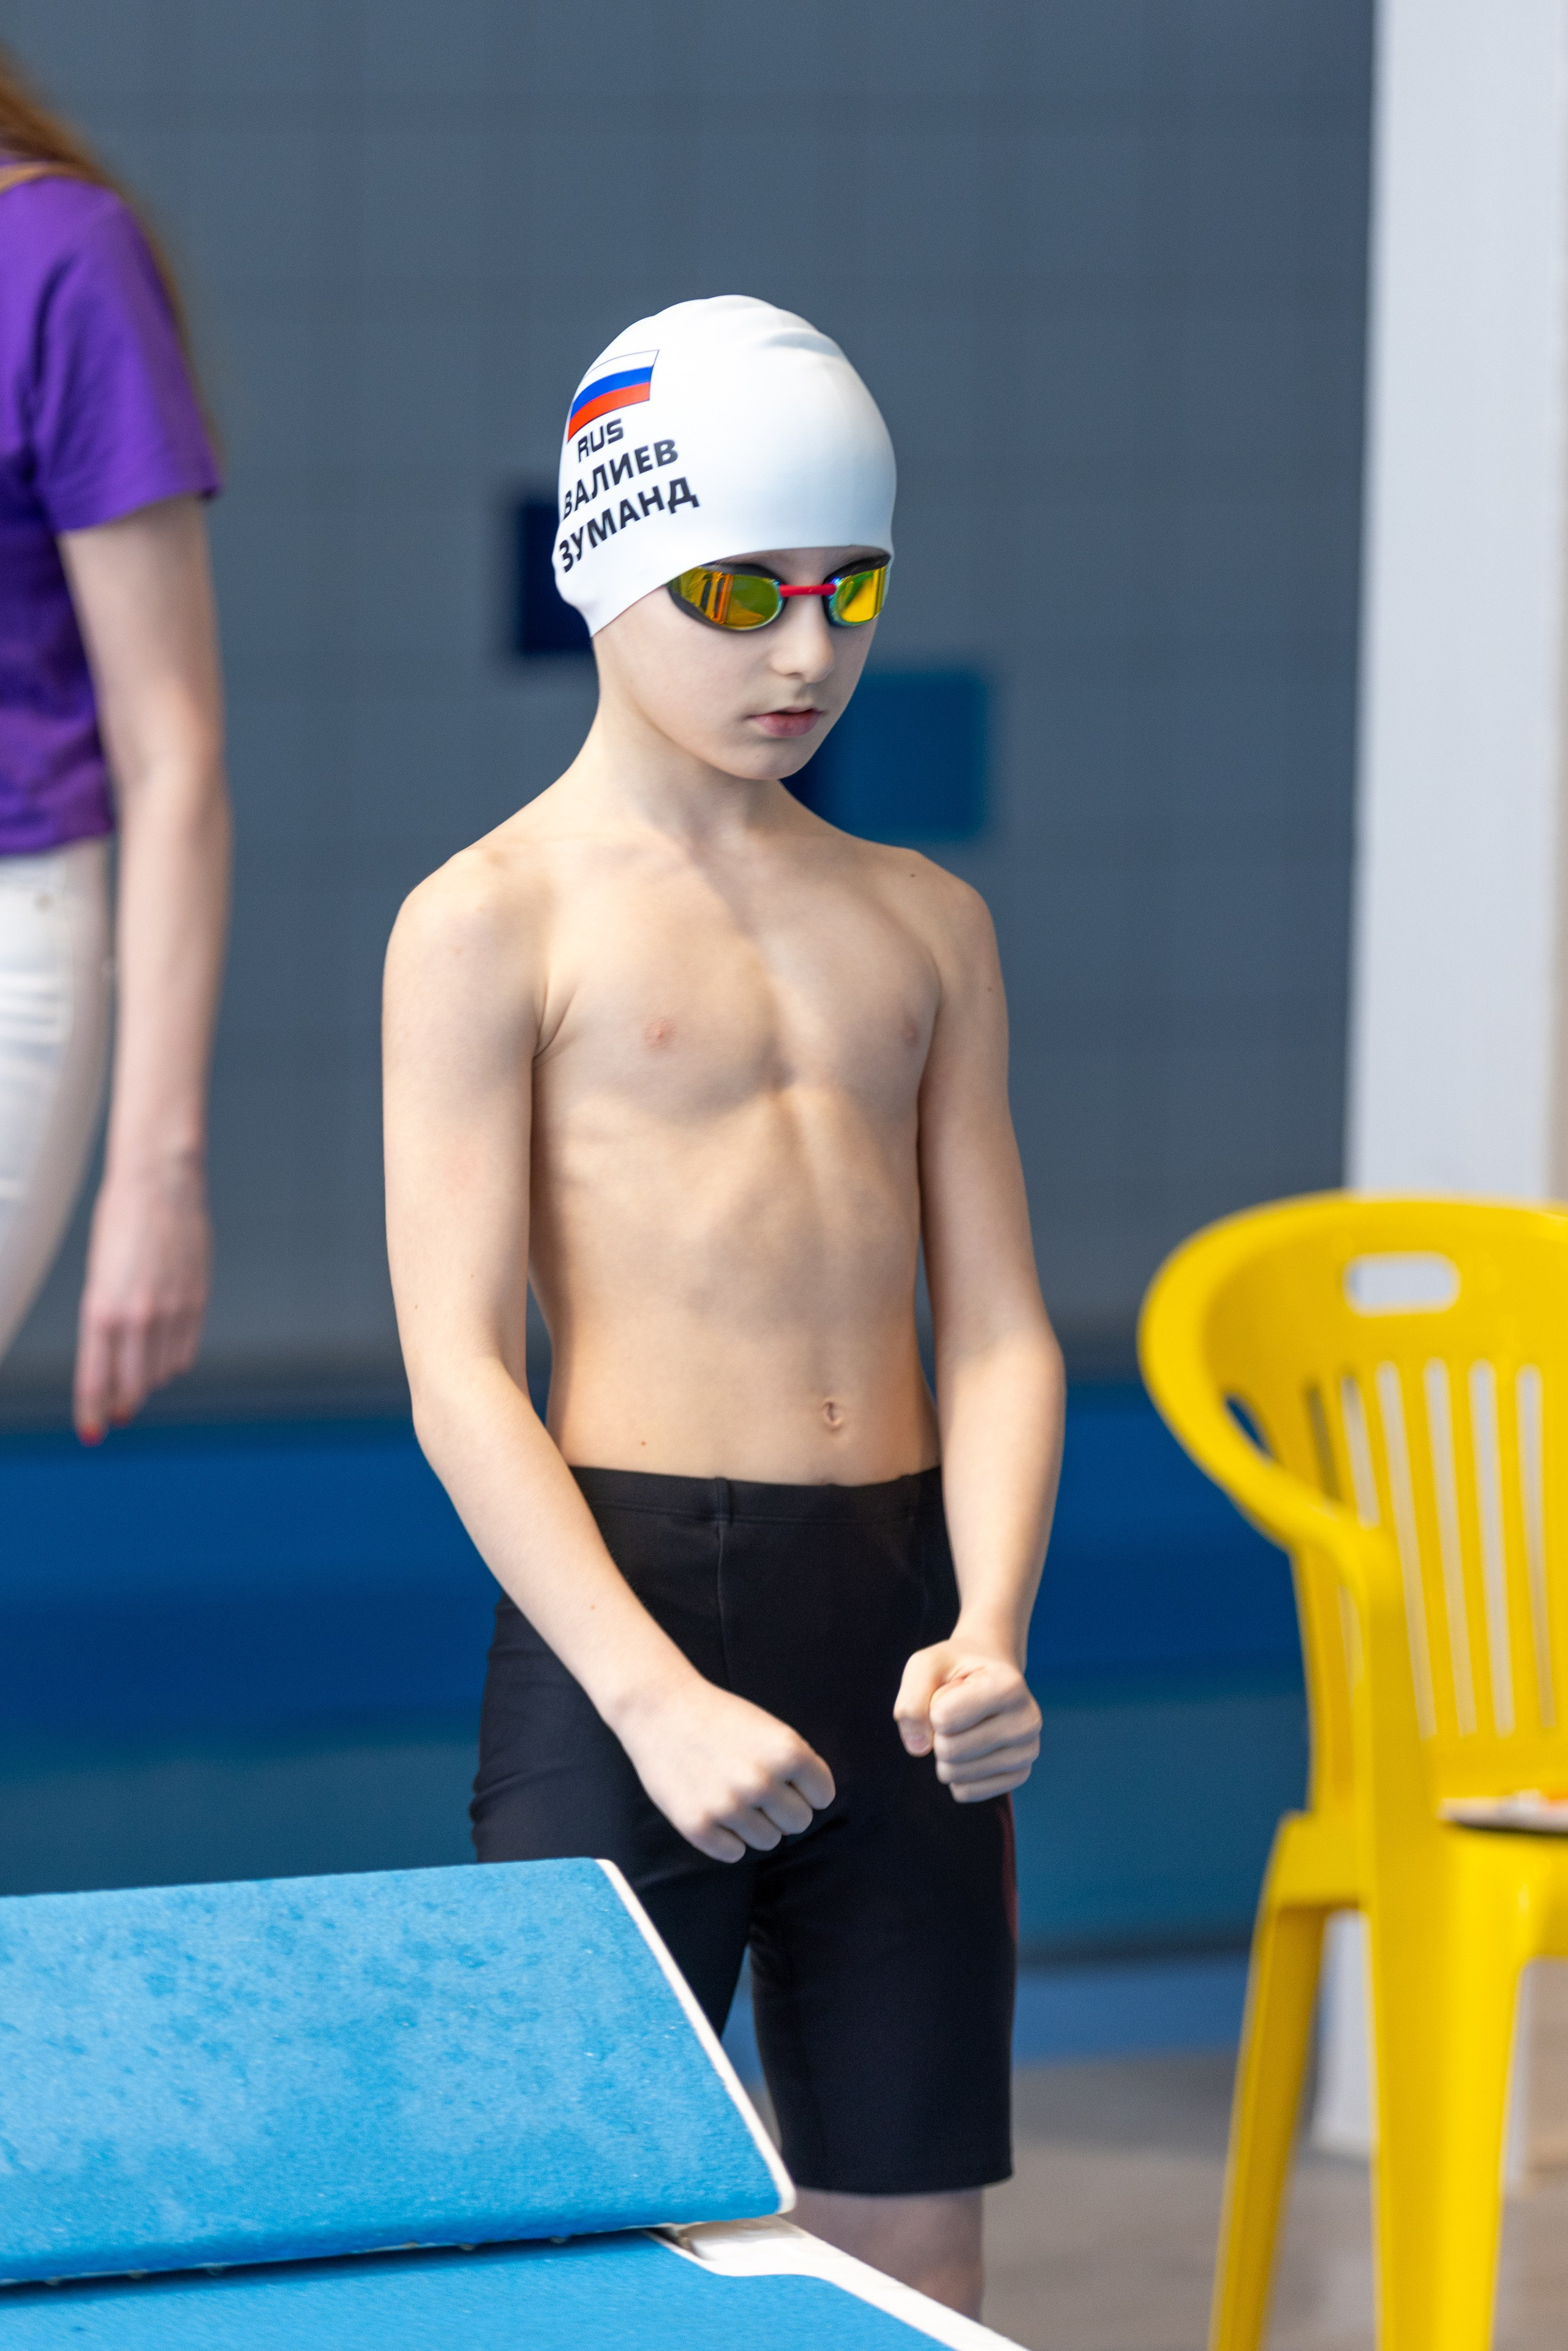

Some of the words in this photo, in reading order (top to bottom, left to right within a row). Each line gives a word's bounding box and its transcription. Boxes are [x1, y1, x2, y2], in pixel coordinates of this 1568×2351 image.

[563, 439, 679, 521] ВАЛИЕВ
[577, 418, 624, 463] RUS
[559, 477, 701, 573] ЗУМАНД
